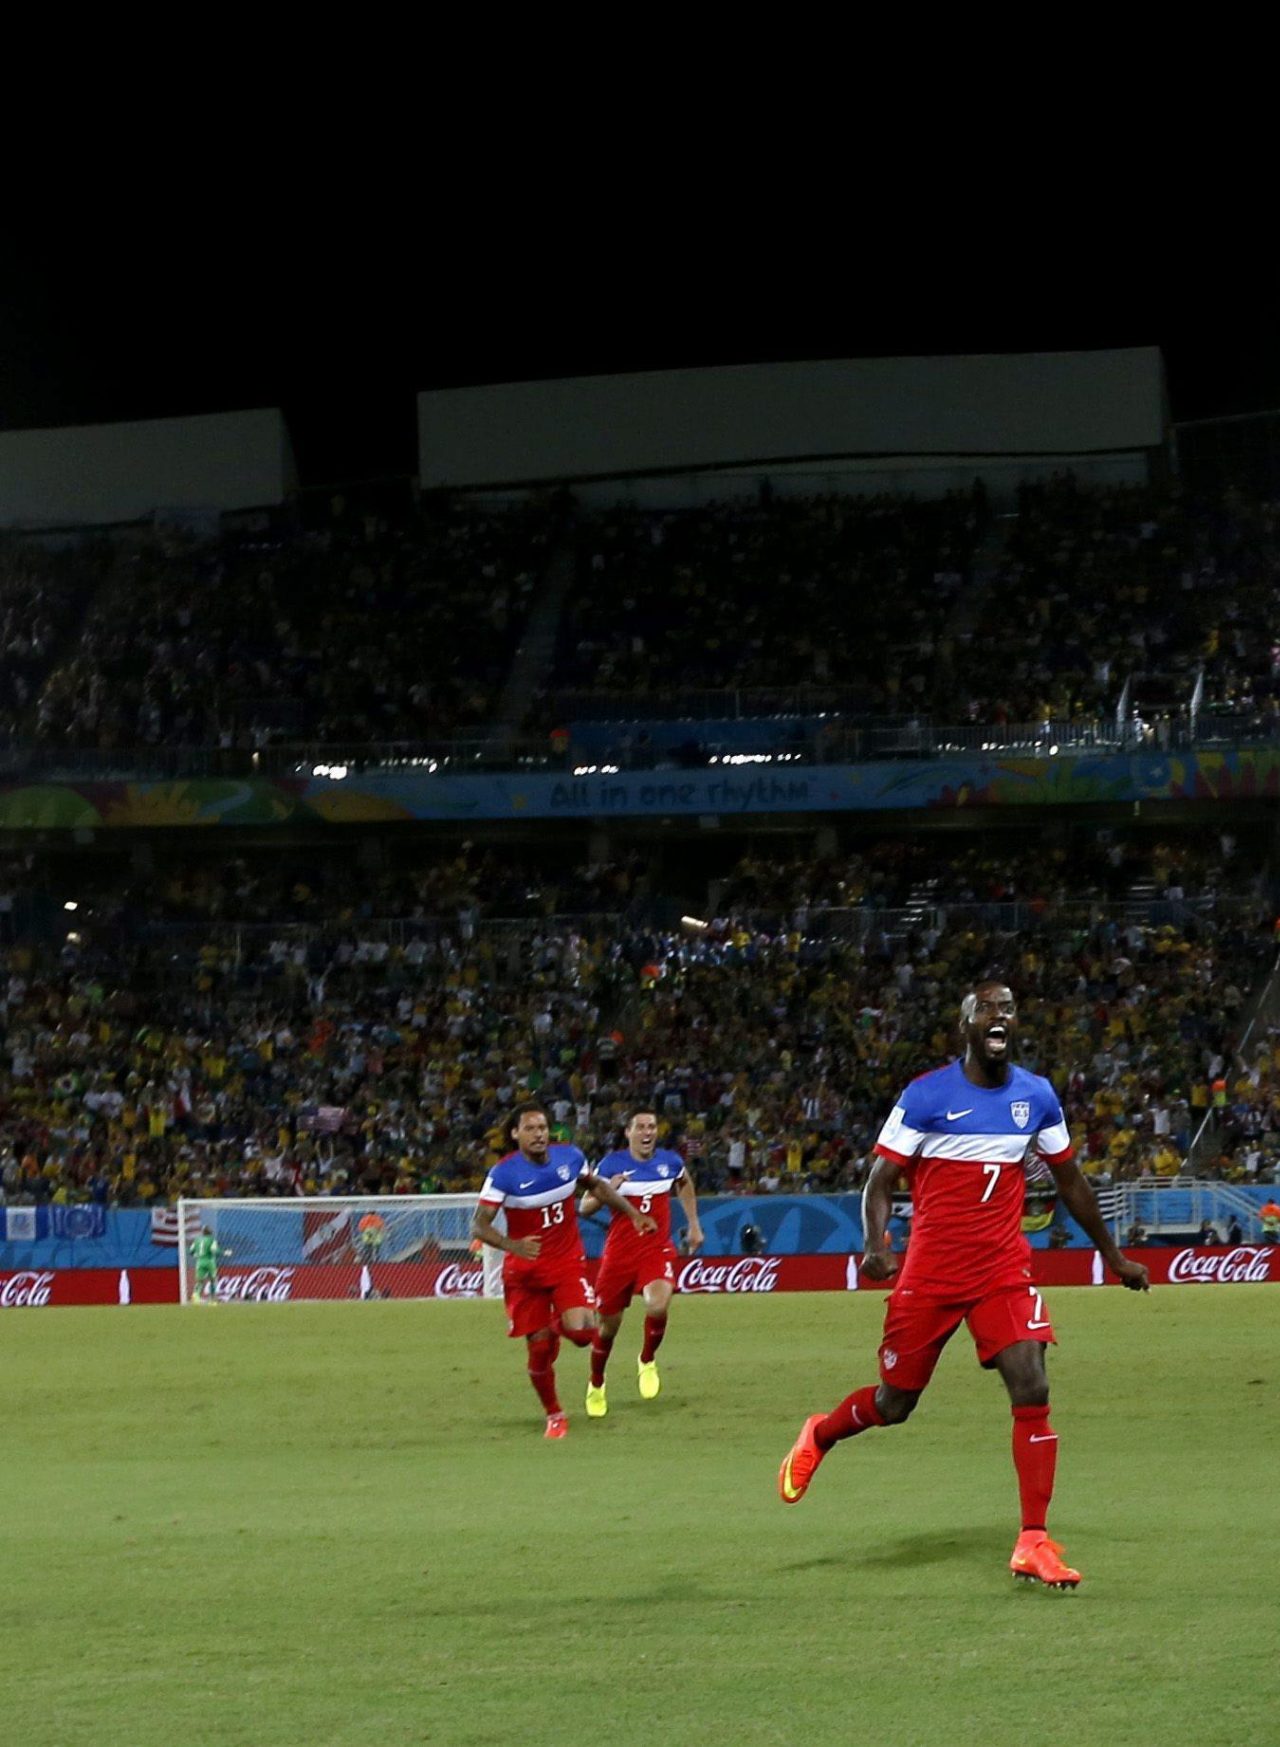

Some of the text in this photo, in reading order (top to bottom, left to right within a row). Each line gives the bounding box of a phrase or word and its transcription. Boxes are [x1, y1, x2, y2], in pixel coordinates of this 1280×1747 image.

[549, 781, 590, 809] All
[599, 780, 628, 807] in
[639, 783, 696, 807] one
[981, 1164, 1001, 1203] 7
[541, 1202, 565, 1229] 13
[640, 1195, 653, 1213] 5
[677, 1256, 782, 1292] Coca-Cola
[1168, 1246, 1275, 1283] Coca-Cola
[0, 1271, 55, 1307] Cola
